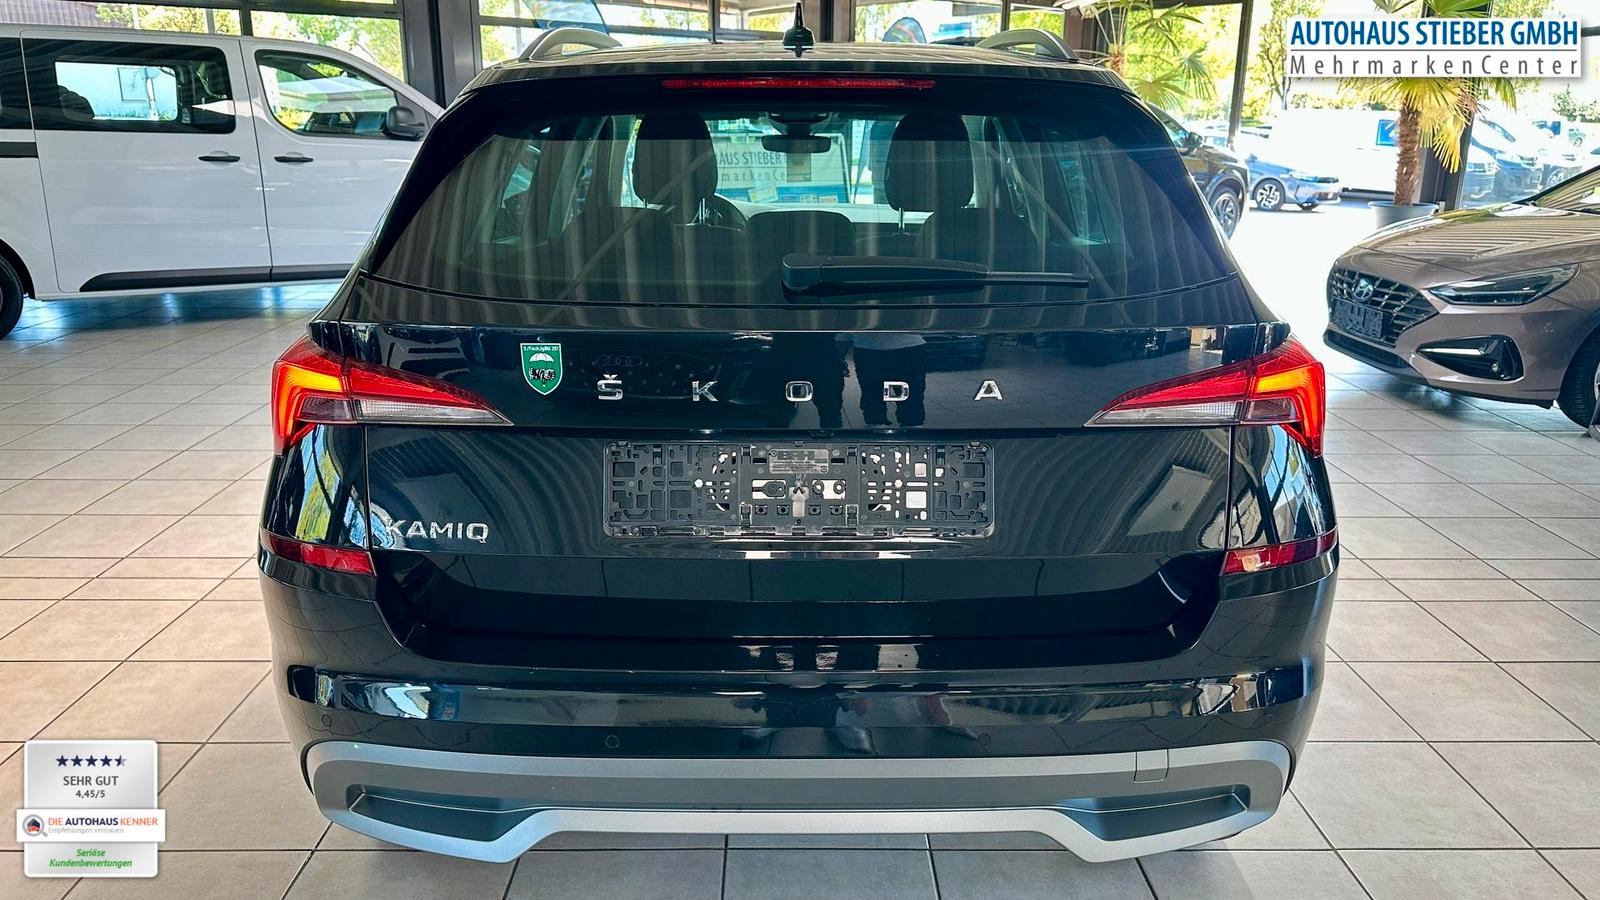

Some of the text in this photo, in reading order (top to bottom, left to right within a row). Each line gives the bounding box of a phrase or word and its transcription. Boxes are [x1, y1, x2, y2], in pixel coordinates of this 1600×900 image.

[719, 152, 782, 165] AUS STIEBER
[386, 520, 489, 544] KAMIQ
